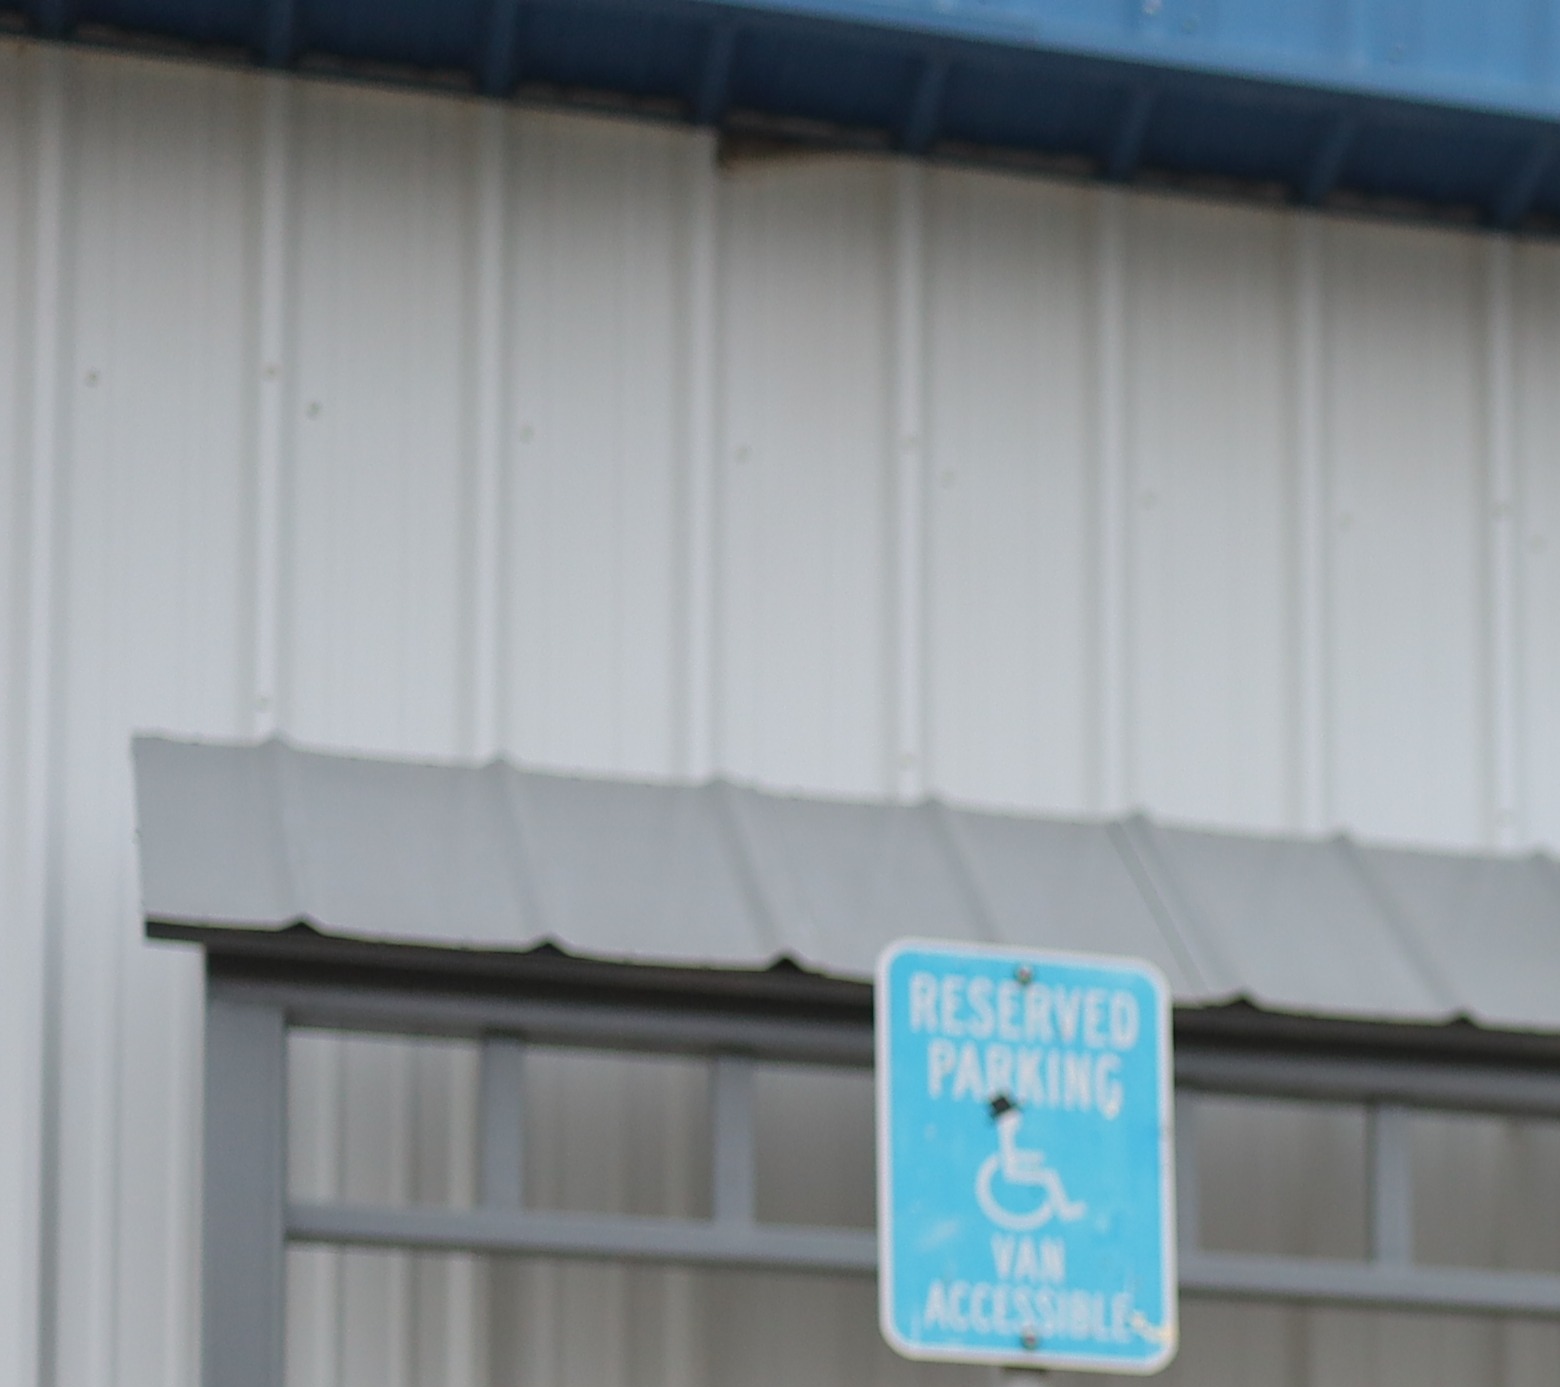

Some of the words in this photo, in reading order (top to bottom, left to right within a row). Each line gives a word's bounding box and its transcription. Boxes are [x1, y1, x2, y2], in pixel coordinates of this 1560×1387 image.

[909, 971, 1140, 1051] RESERVED
[927, 1039, 1124, 1121] PARKING
[991, 1234, 1067, 1284] VAN
[923, 1280, 1133, 1344] ACCESSIBLE
